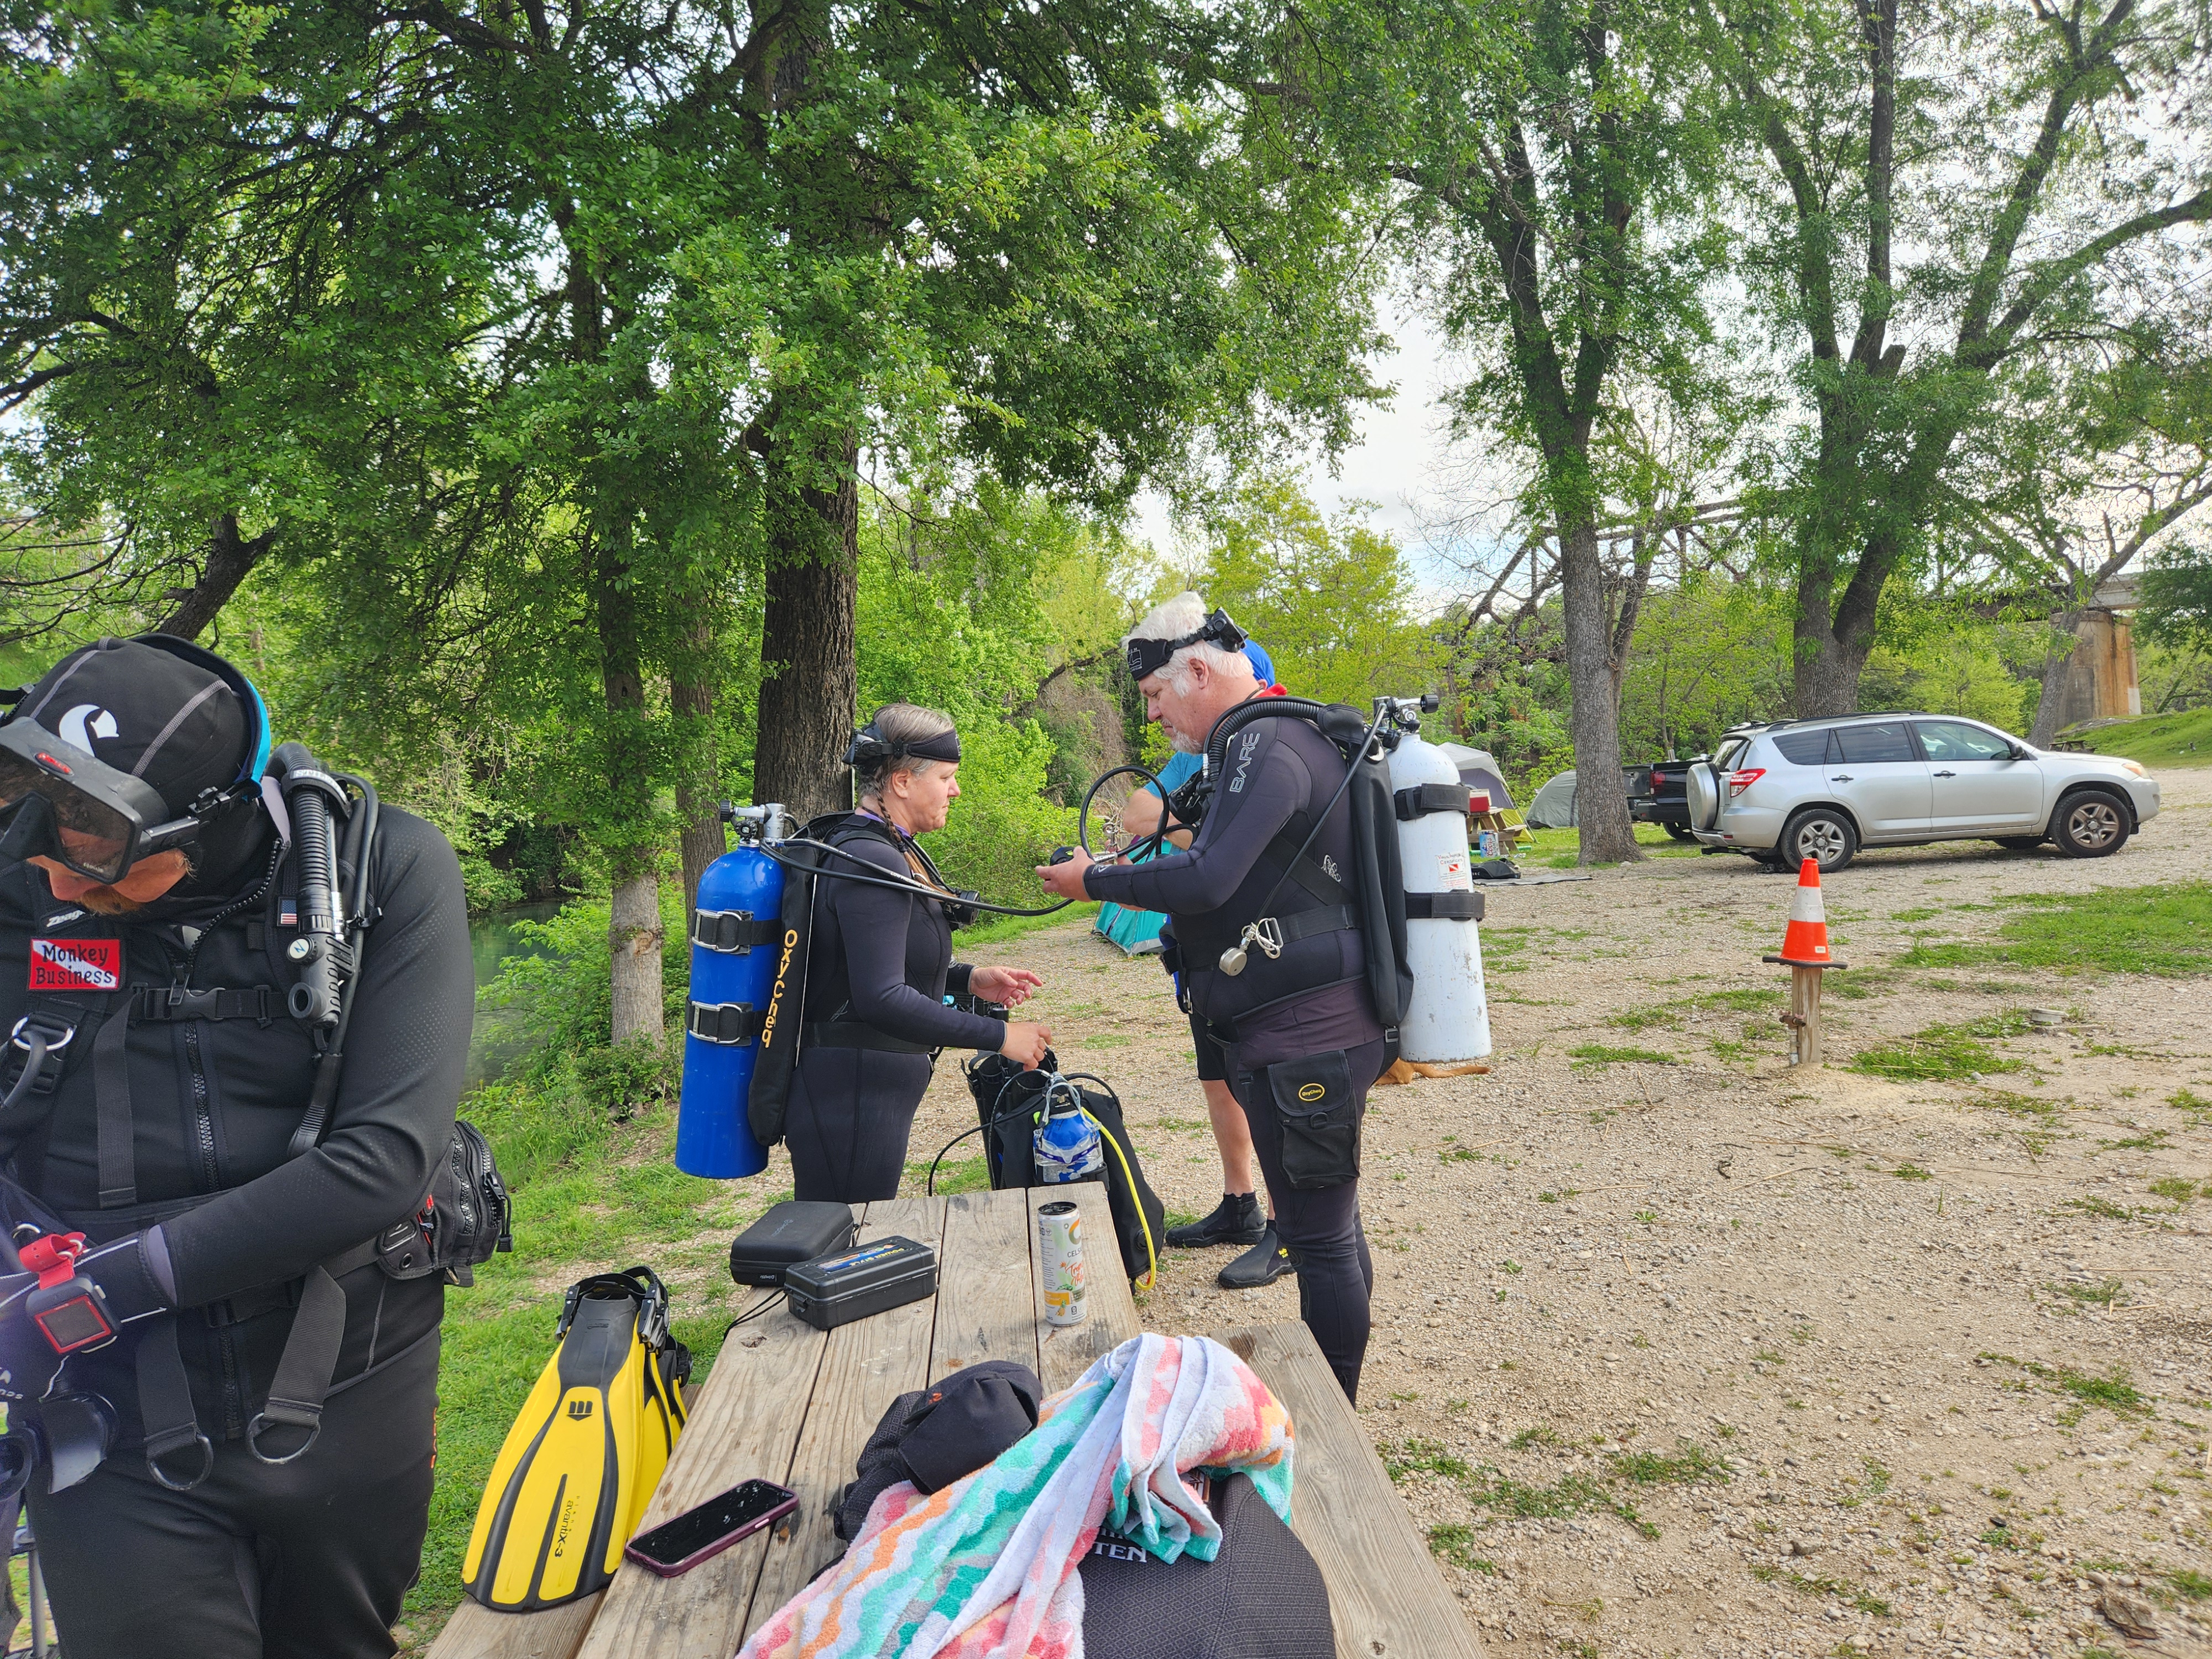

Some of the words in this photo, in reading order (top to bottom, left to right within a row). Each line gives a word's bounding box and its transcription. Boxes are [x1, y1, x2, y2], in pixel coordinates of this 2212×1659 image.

[46, 910, 86, 927] Zeag
[42, 944, 108, 967] Monkey
[36, 966, 113, 984] Business
[1067, 1248, 1082, 1258] CELS
